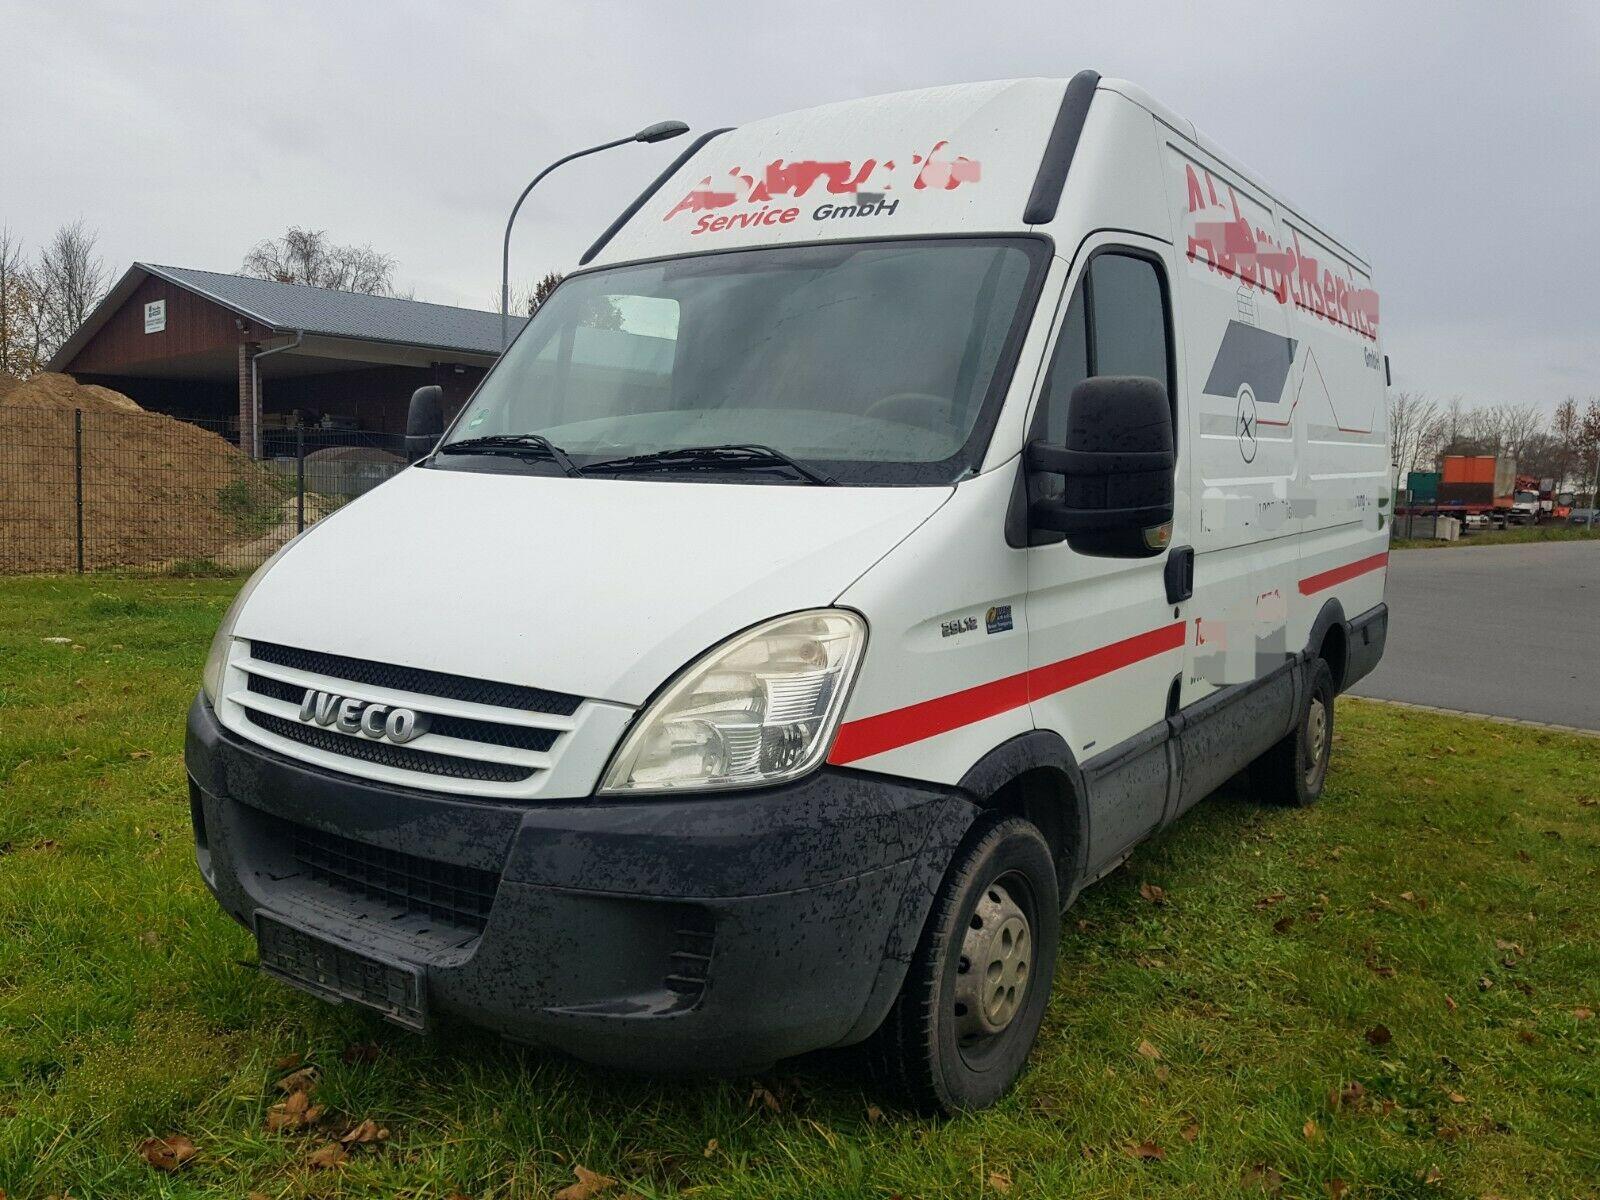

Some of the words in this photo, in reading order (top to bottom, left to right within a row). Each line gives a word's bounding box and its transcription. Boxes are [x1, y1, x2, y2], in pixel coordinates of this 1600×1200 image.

[691, 205, 800, 235] Service
[812, 199, 900, 221] GmbH
[299, 689, 420, 744] IVECO
